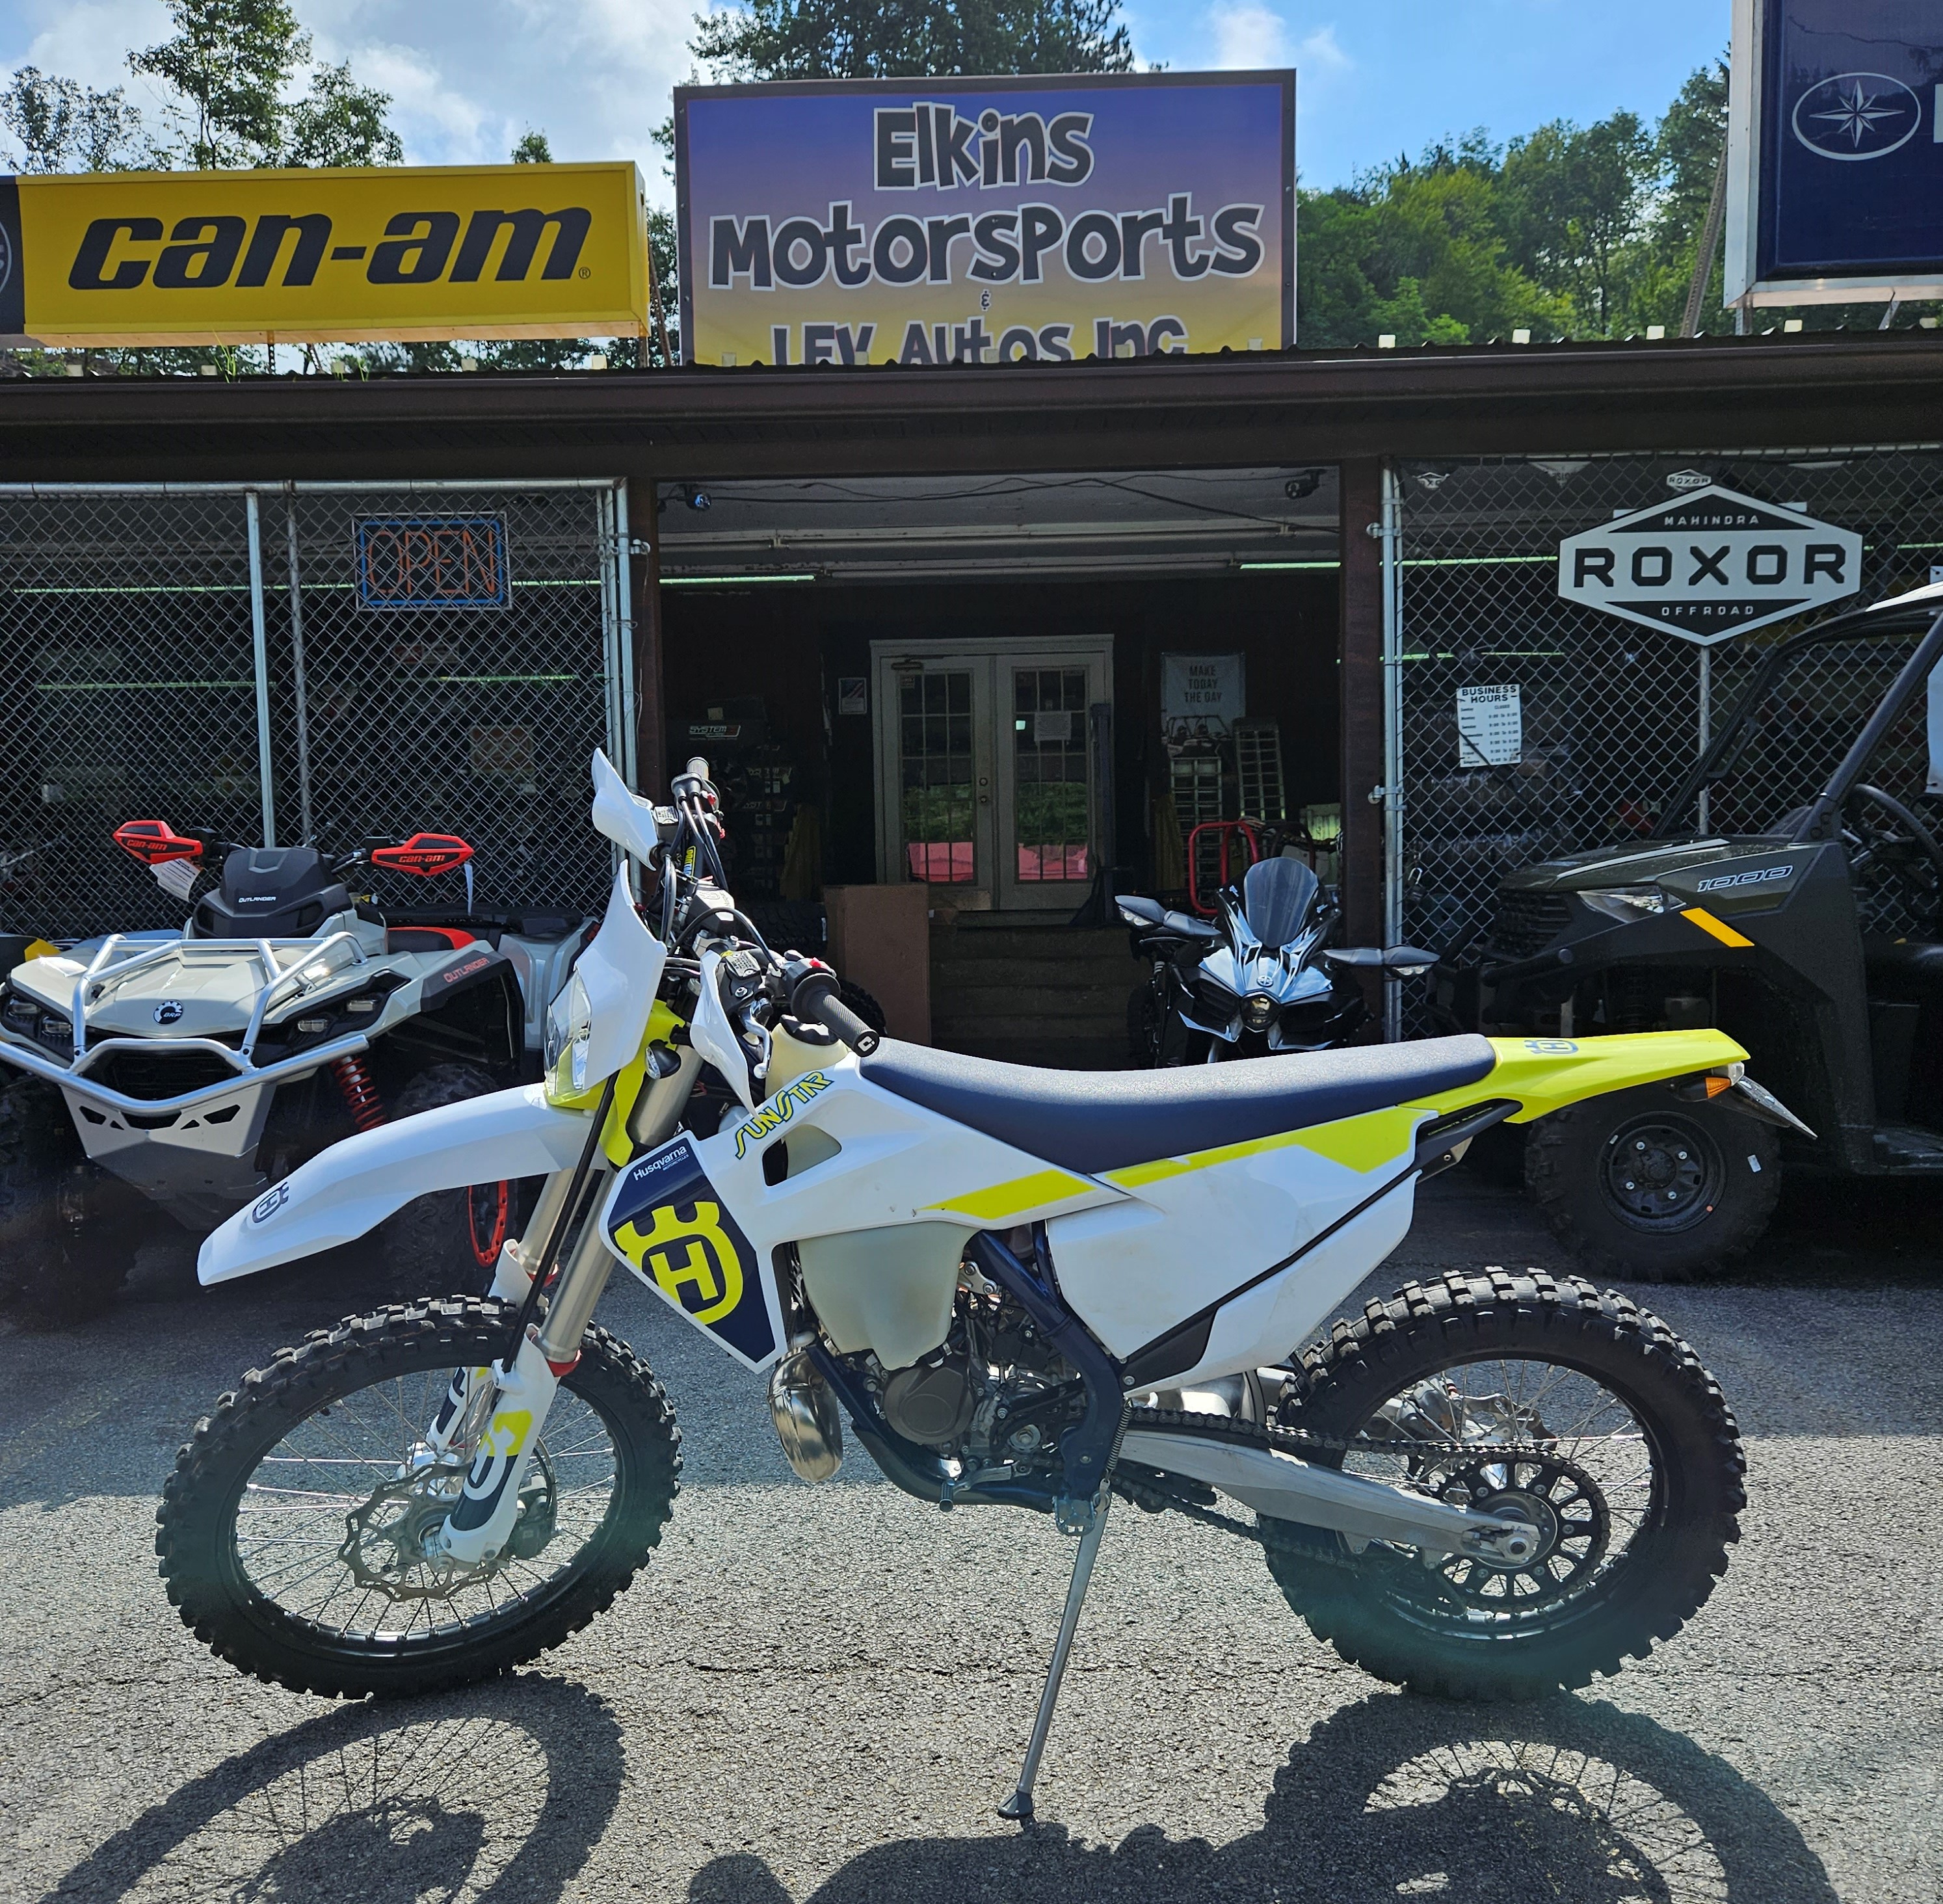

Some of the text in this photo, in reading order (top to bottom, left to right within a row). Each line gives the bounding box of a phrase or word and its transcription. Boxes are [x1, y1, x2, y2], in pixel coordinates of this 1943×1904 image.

[873, 101, 1095, 191] Elkins
[709, 192, 1265, 291] Motorsports
[68, 207, 592, 290] can-am
[1664, 515, 1759, 525] MAHINDRA
[367, 529, 496, 594] OPEN
[1573, 544, 1846, 588] ROXOR
[1661, 606, 1754, 616] OFFROAD
[1189, 665, 1216, 676] MAKE
[1188, 678, 1218, 689] TODAY
[1462, 685, 1516, 696] BUSINESS
[1184, 691, 1222, 703] THE DAY
[1471, 694, 1508, 704] HOURS
[127, 840, 168, 851] can-am
[399, 854, 445, 863] can-am
[1697, 866, 1793, 893] 1000
[443, 957, 490, 983] OUTLANDER
[633, 1146, 687, 1181] Husqvarna
